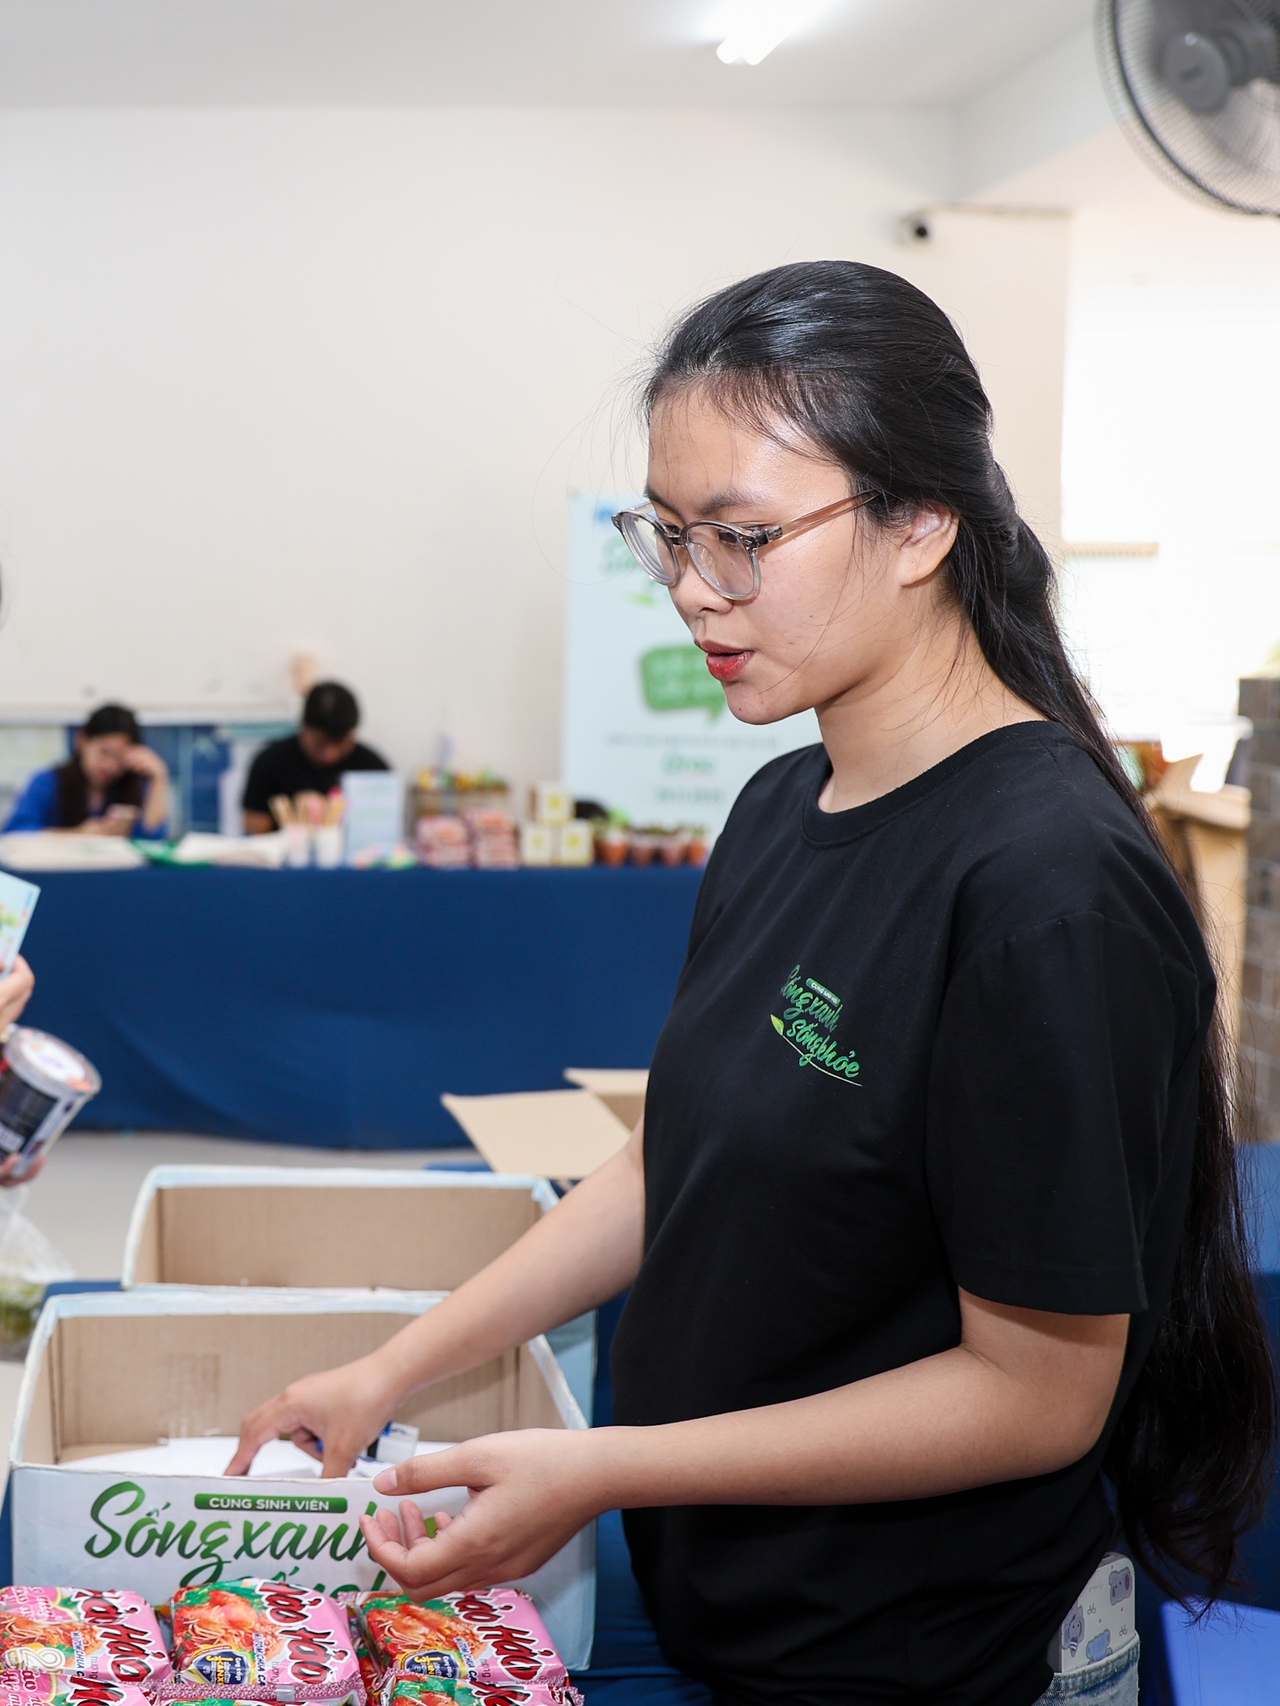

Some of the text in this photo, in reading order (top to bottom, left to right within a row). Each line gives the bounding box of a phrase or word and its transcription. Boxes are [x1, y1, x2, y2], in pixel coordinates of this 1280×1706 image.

[208, 1497, 330, 1512] CÙNG SINH VIÊN
[279, 1626, 349, 1684] Hảo
[477, 1625, 554, 1681] Hảo
